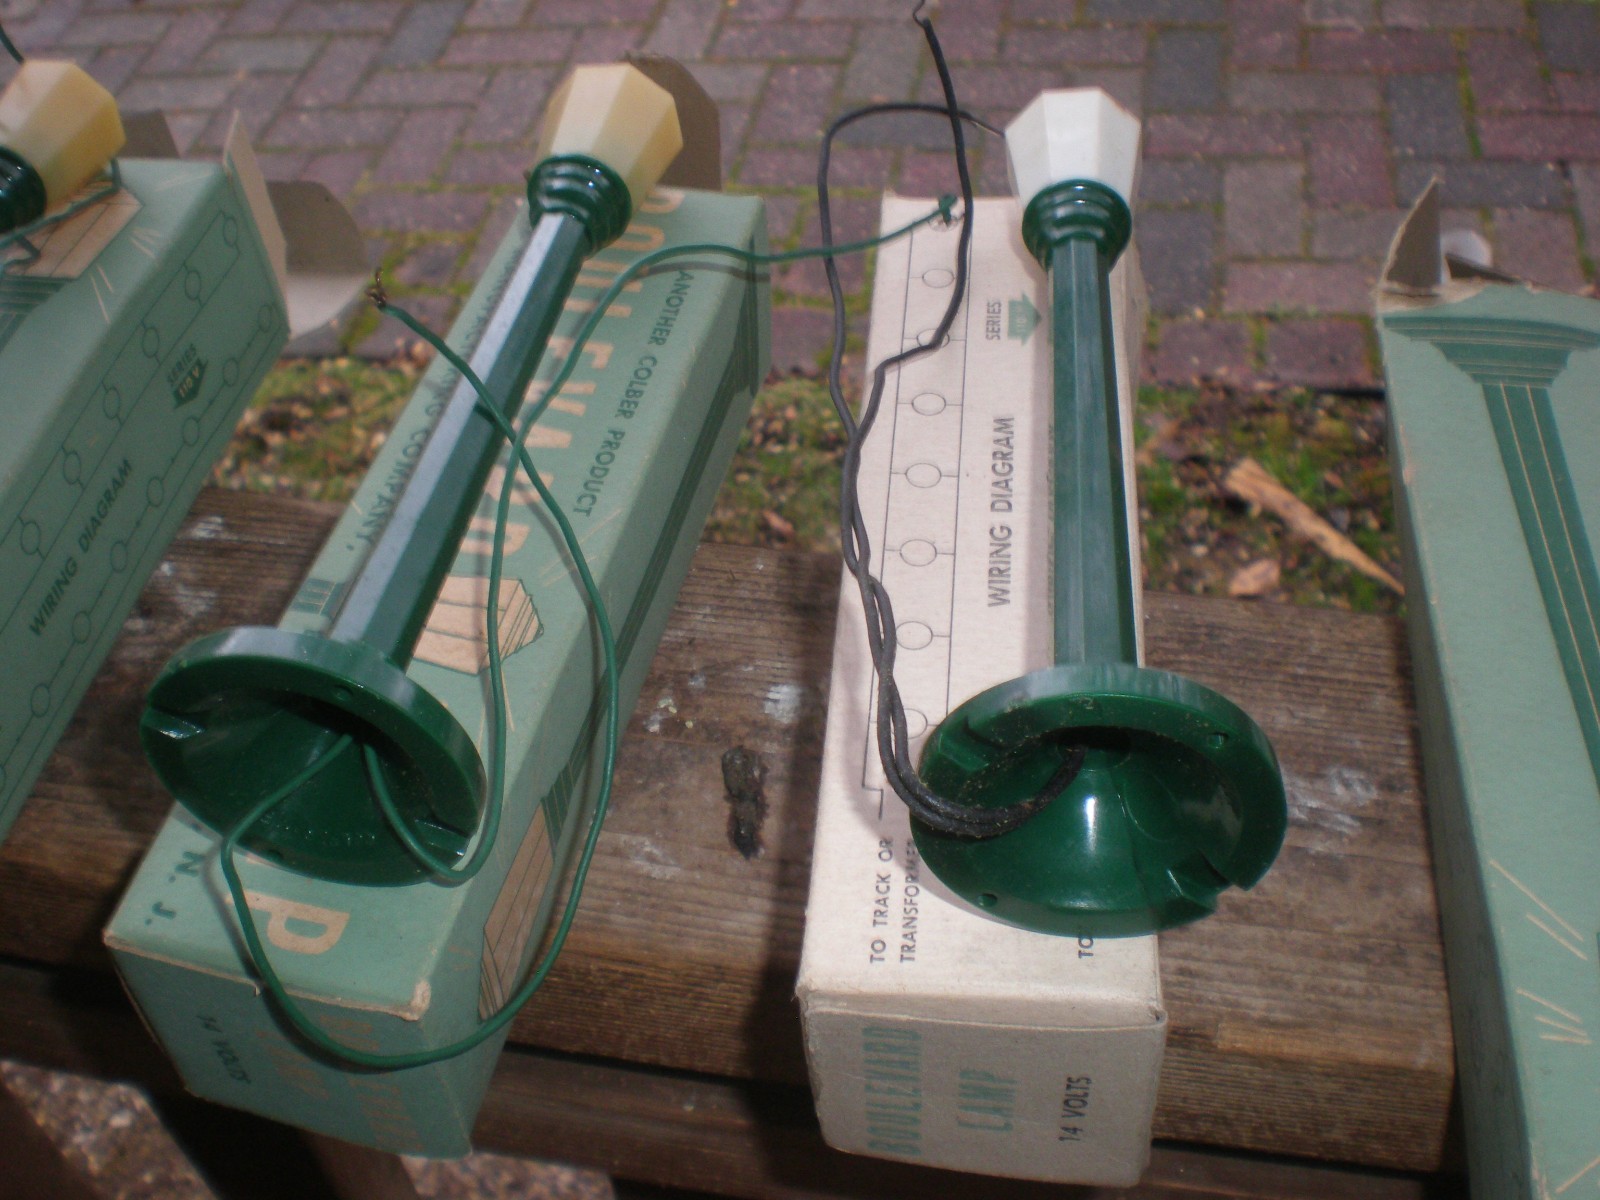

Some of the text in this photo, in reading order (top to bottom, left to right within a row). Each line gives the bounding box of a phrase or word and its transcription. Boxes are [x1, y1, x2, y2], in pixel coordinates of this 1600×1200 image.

[165, 342, 199, 384] SERIES
[985, 300, 1002, 341] SERIES
[571, 269, 695, 518] ANOTHER COLBER PRODUCT
[29, 457, 133, 637] WIRING DIAGRAM
[987, 415, 1014, 608] WIRING DIAGRAM
[869, 836, 894, 964] TO TRACK OR
[861, 1026, 922, 1155] BOULEVARD
[957, 1068, 1018, 1132] LAMP
[1057, 1075, 1093, 1142] 14 VOLTS
